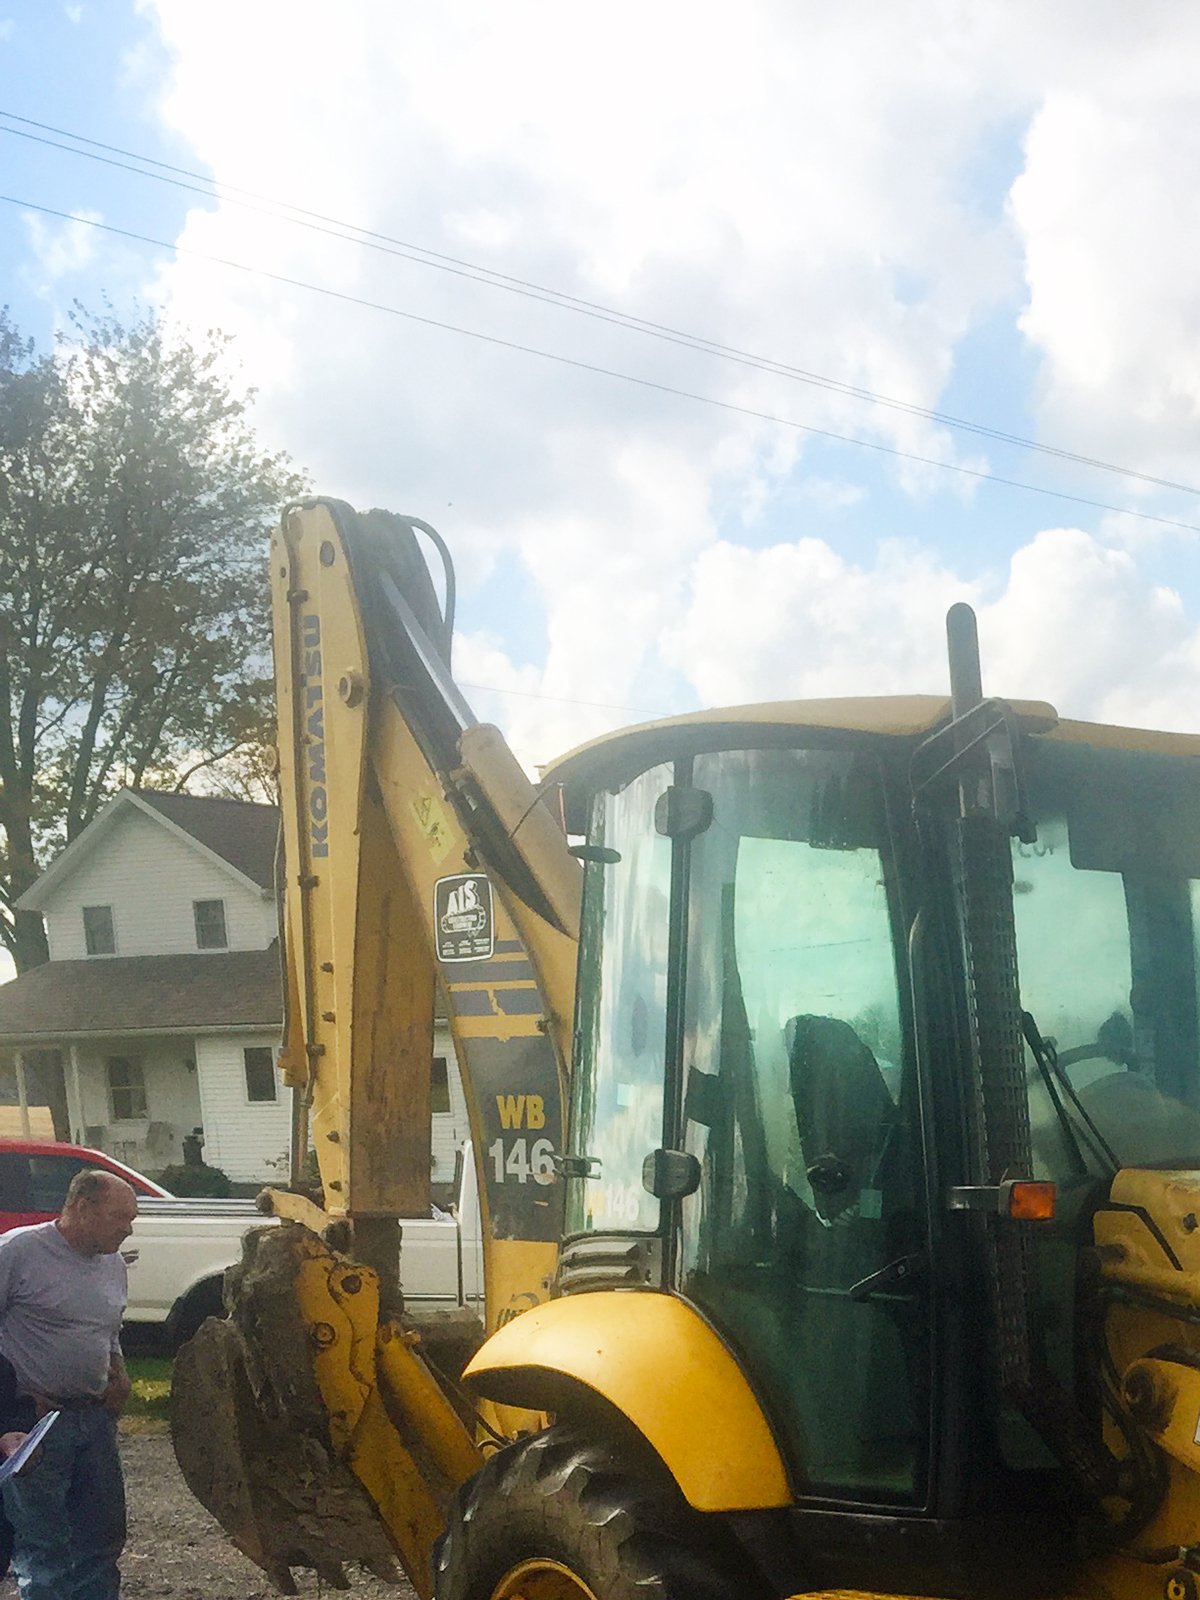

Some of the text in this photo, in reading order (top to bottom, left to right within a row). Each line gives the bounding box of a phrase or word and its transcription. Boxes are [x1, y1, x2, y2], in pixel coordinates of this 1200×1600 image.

[303, 614, 330, 858] KOMATSU
[447, 880, 479, 914] AIS
[496, 1094, 545, 1130] WB
[489, 1137, 556, 1186] 146
